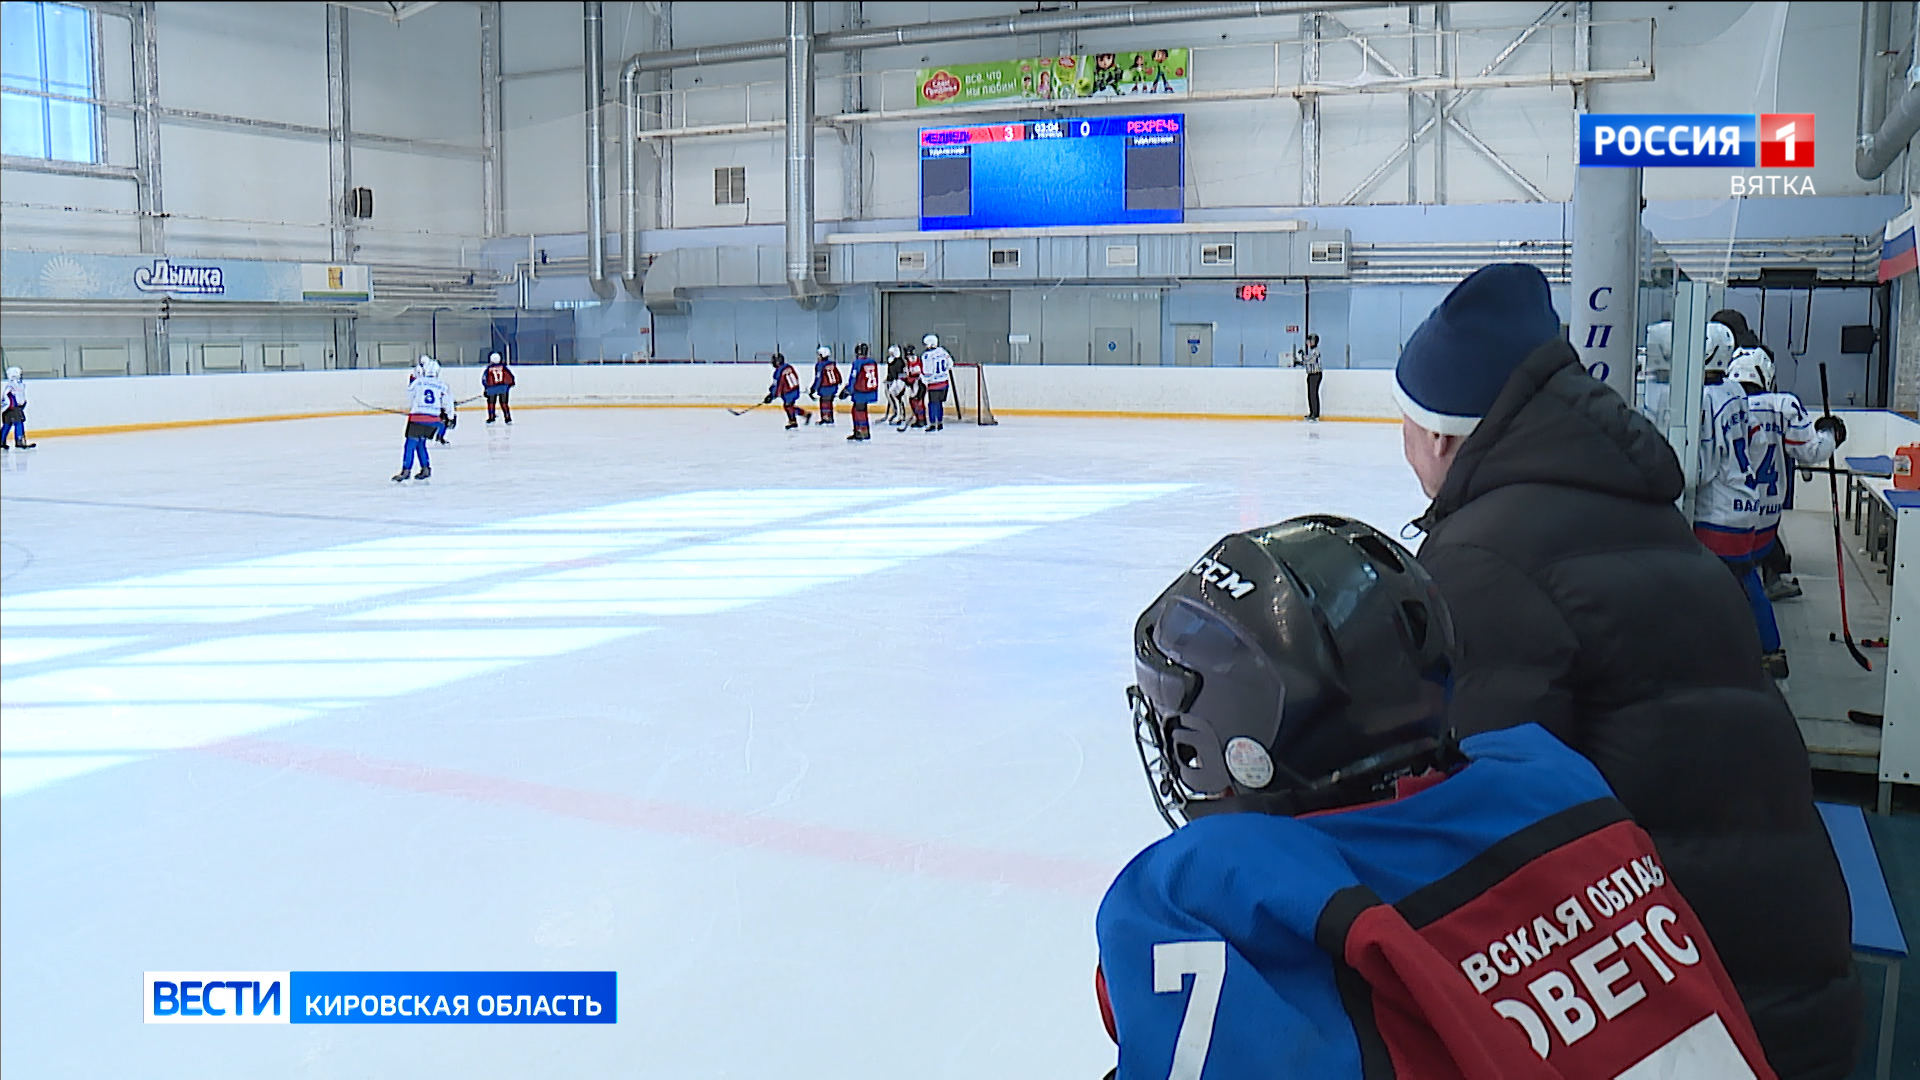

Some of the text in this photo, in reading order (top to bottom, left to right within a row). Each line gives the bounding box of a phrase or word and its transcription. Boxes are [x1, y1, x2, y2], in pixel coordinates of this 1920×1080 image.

[1004, 126, 1014, 141] 3
[1080, 121, 1091, 137] 0
[136, 258, 223, 290] Дымка
[1191, 556, 1256, 600] CCM
[1153, 940, 1227, 1080] 7
